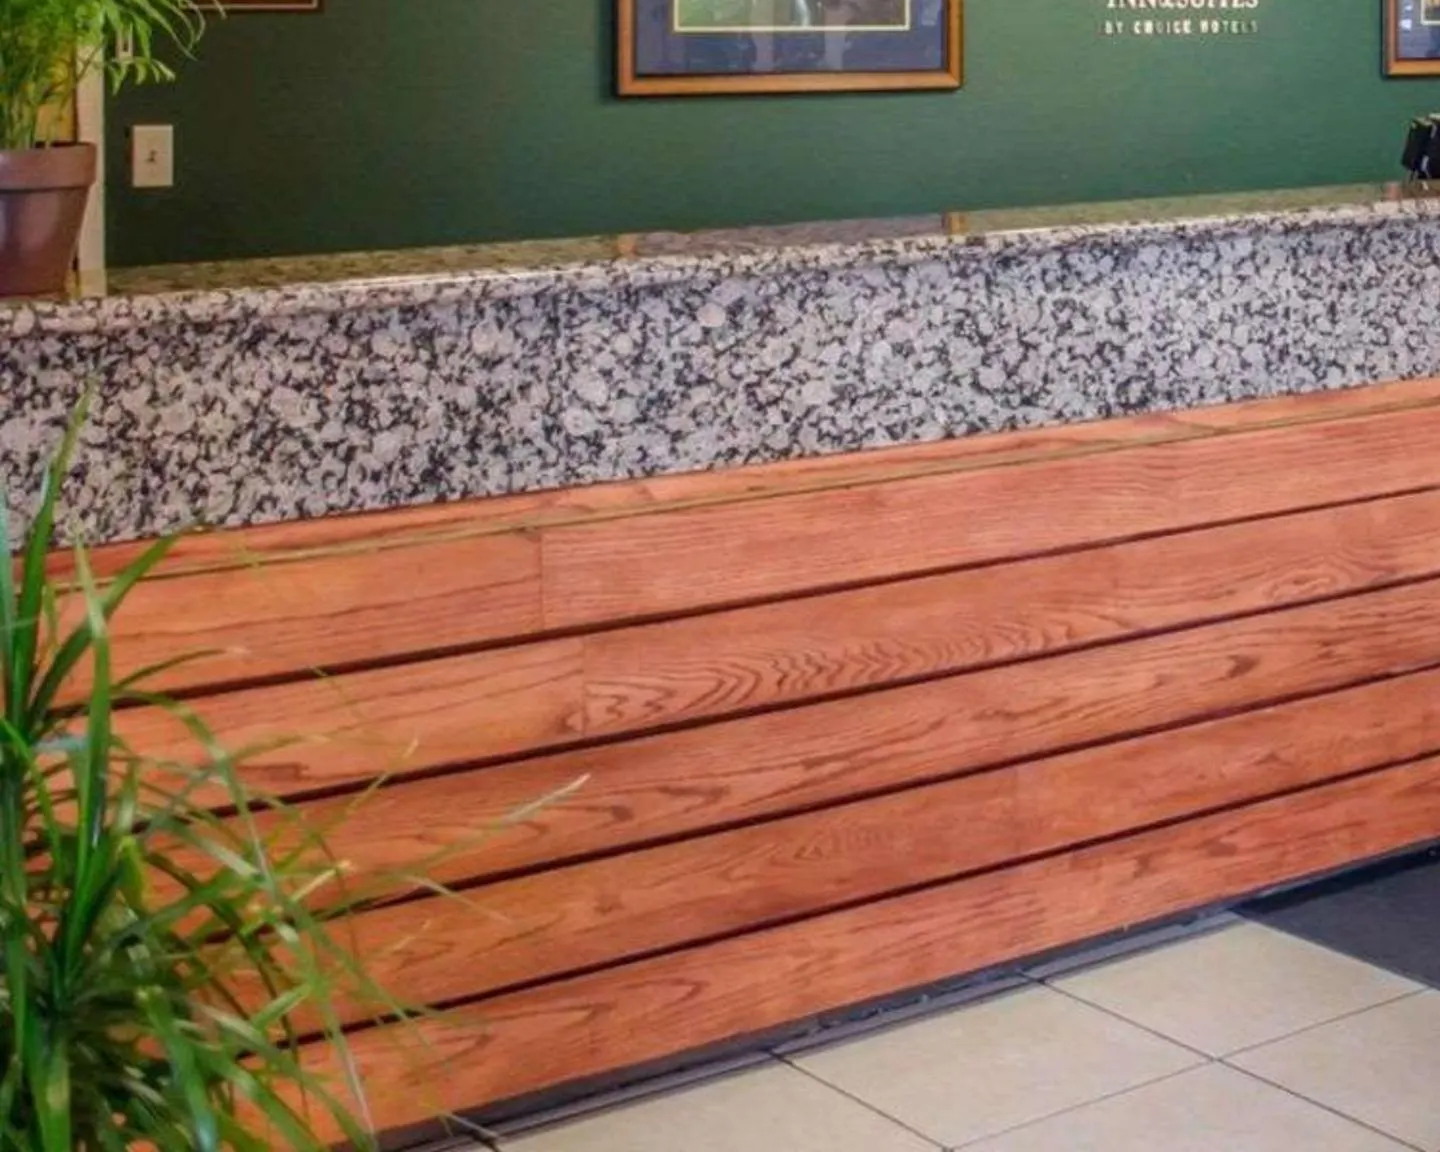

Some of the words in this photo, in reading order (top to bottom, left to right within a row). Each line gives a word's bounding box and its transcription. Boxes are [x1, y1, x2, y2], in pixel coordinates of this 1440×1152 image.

[1104, 21, 1124, 35] BY
[1133, 20, 1192, 36] CHOICE
[1200, 20, 1259, 35] HOTELS
